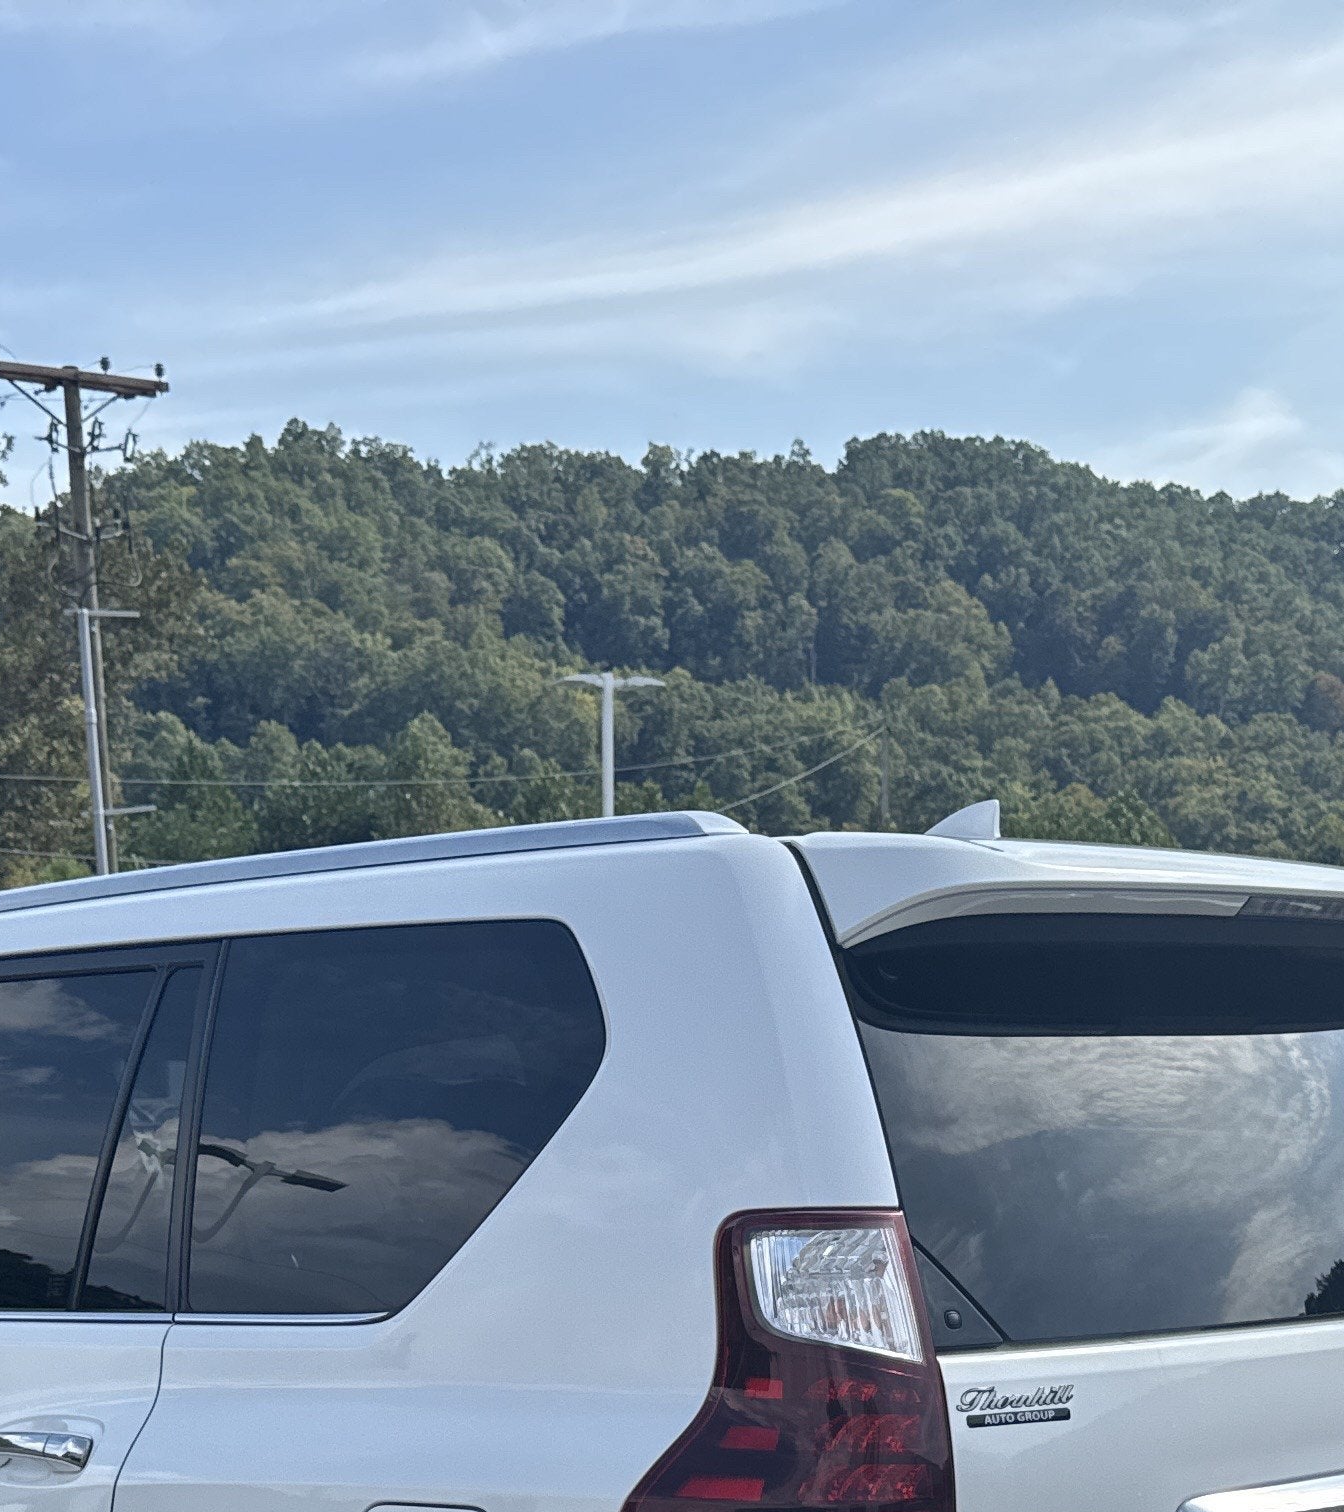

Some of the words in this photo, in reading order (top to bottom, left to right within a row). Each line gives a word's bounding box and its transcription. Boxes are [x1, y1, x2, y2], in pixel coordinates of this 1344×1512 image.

[956, 1384, 1074, 1412] Thornhill
[984, 1411, 1015, 1425] AUTO
[1016, 1409, 1056, 1422] GROUP
